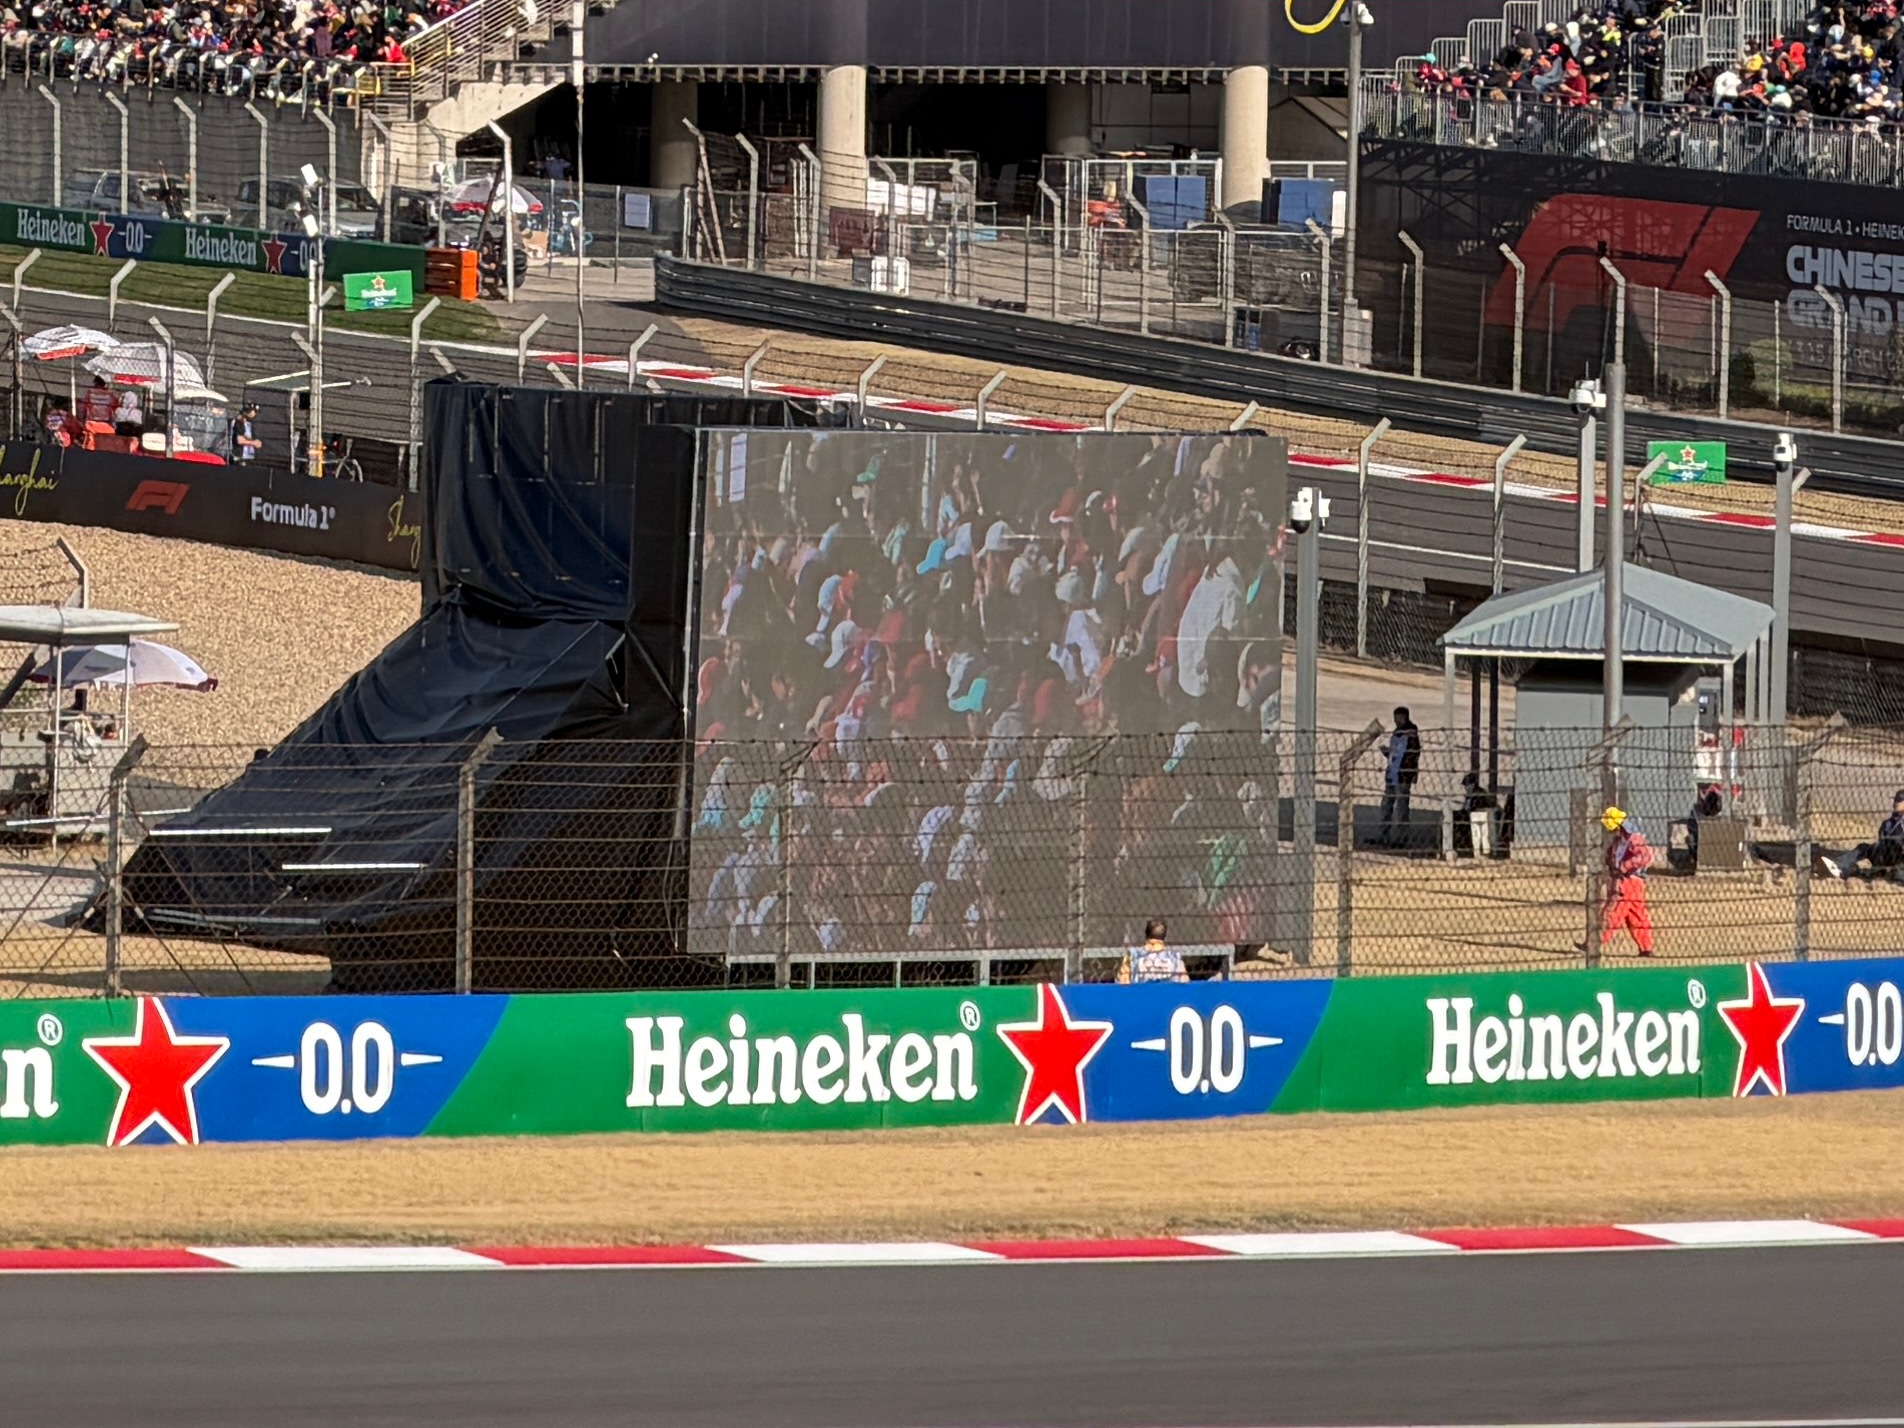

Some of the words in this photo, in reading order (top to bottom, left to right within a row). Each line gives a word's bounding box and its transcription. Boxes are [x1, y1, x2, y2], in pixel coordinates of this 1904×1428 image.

[17, 208, 86, 246] Heineken
[1786, 214, 1842, 233] FORMULA
[185, 226, 258, 266] Heineken
[1787, 288, 1893, 336] GRND
[251, 496, 318, 529] Formula
[301, 1021, 394, 1114] 0.0
[1170, 1005, 1245, 1094] 0.0
